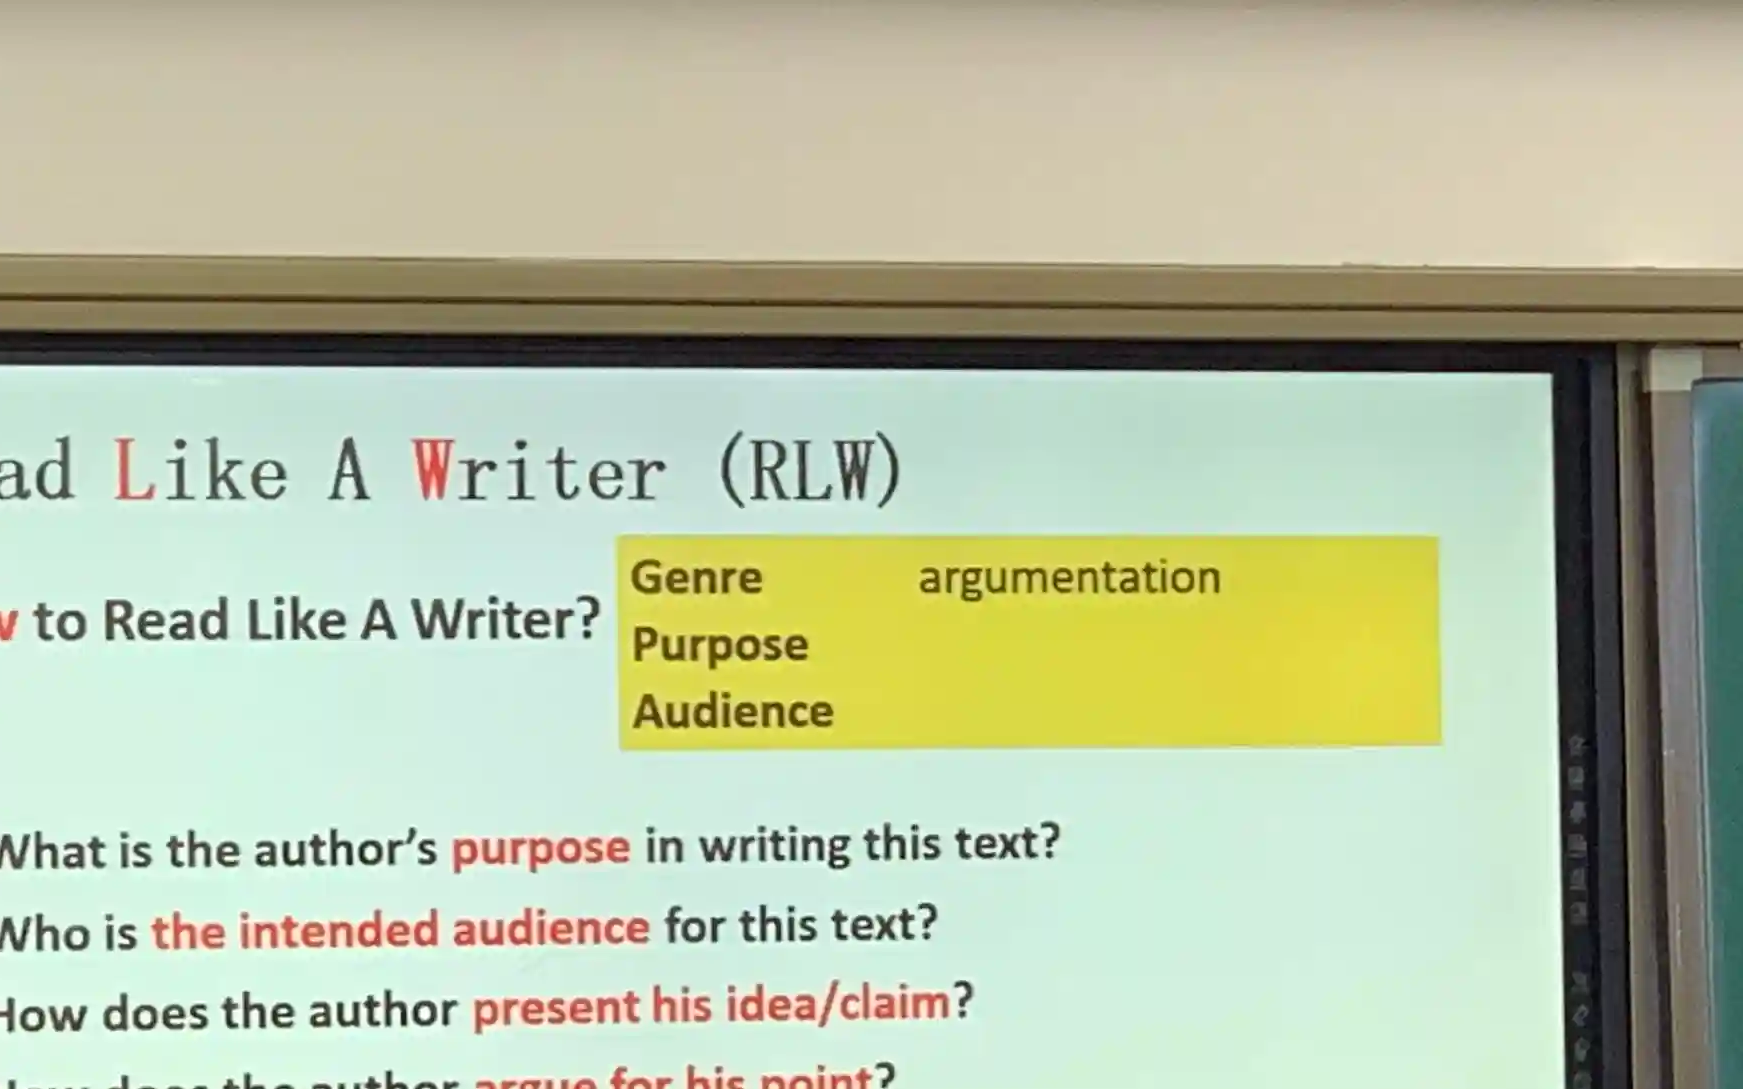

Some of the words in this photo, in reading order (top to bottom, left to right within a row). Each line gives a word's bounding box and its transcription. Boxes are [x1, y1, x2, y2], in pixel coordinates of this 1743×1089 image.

[115, 436, 287, 500] Like
[327, 436, 371, 500] A
[412, 439, 667, 500] Writer
[721, 430, 899, 509] (RLW)
[631, 559, 762, 595] Genre
[919, 558, 1220, 602] argumentation
[32, 602, 87, 641] to
[105, 596, 229, 641] Read
[248, 596, 347, 641] Like
[360, 598, 398, 640] A
[410, 595, 601, 640] Writer?
[634, 626, 809, 670] Purpose
[632, 690, 834, 729] Audience
[120, 831, 153, 869] is
[166, 829, 242, 868] the
[453, 837, 631, 874] purpose
[646, 826, 684, 863] in
[698, 825, 852, 870] writing
[862, 822, 942, 861] this
[954, 820, 1061, 860] text?
[105, 913, 138, 951] is
[150, 911, 226, 950] the
[240, 908, 438, 949] intended
[454, 907, 650, 946] audience
[664, 905, 727, 944] for
[738, 904, 818, 943] this
[830, 902, 938, 941] text?
[103, 992, 209, 1031] does
[220, 990, 296, 1030] the
[309, 988, 459, 1028] author
[474, 991, 641, 1035] present
[653, 985, 712, 1023] his
[728, 979, 974, 1028] idea/claim?
